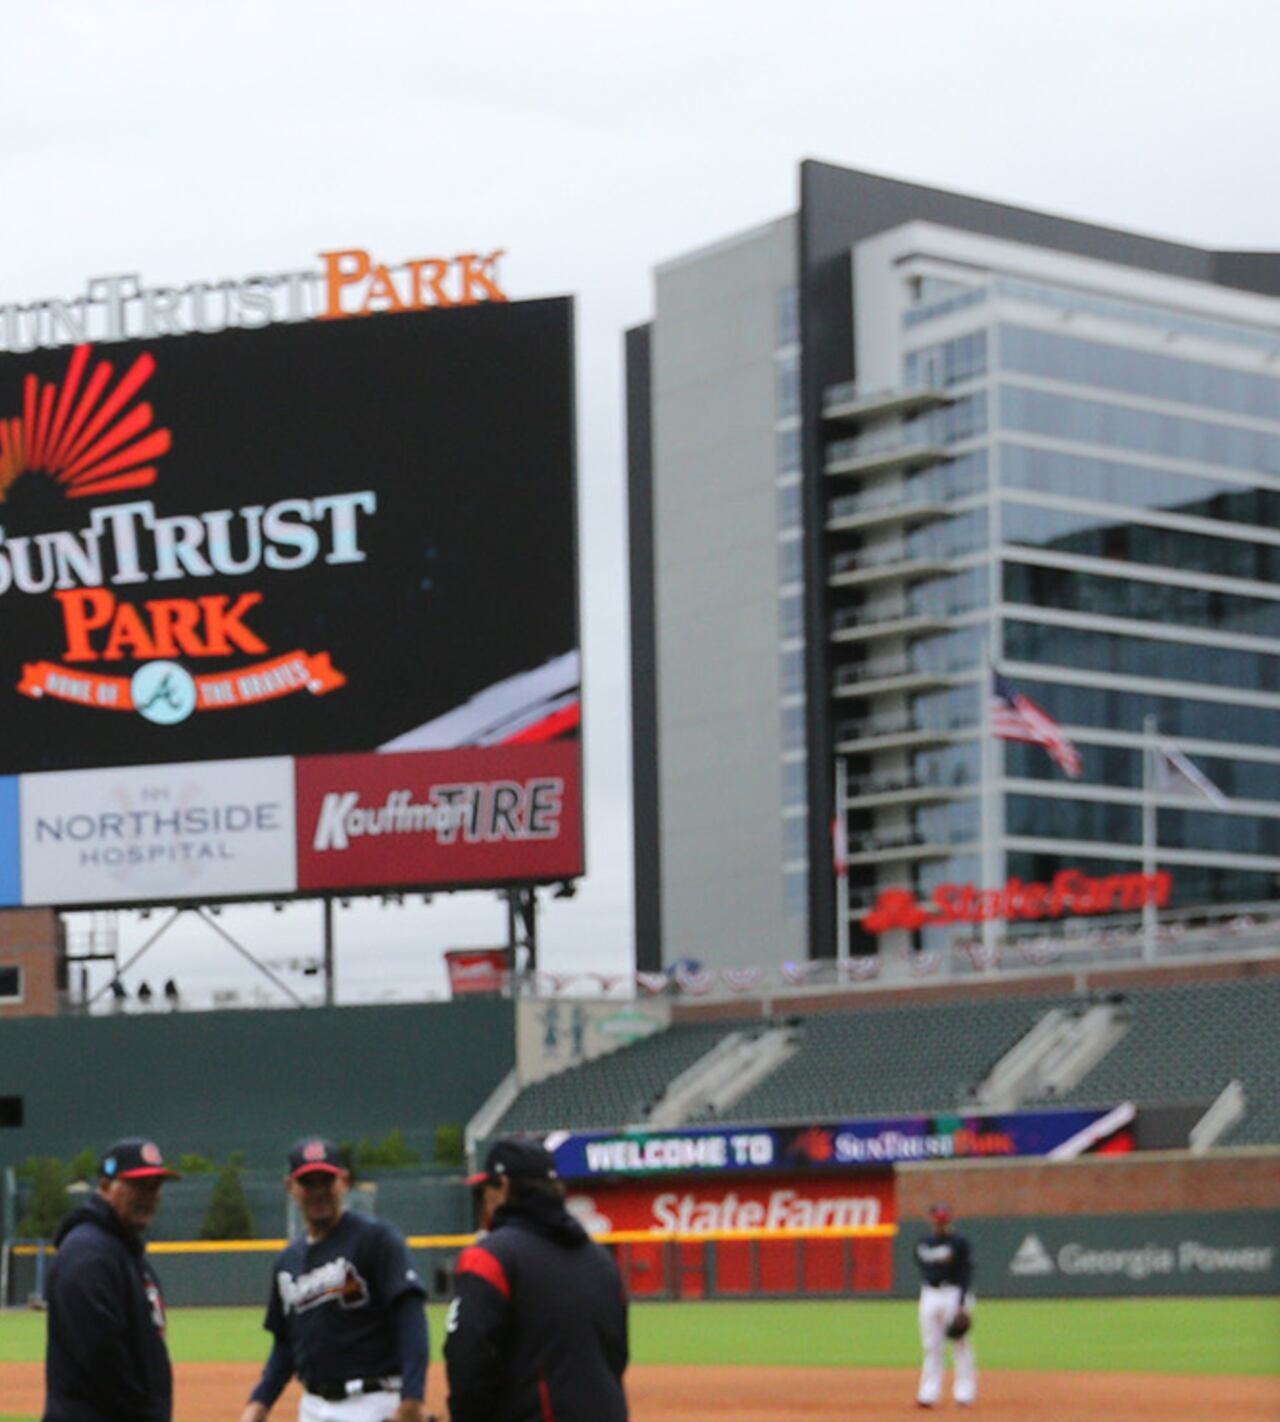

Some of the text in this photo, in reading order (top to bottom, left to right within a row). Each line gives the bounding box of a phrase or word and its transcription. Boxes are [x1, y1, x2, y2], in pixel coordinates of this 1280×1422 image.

[53, 587, 268, 661] PARK
[35, 803, 280, 842] NORTHSIDE
[313, 777, 565, 851] Kauffman TIRE
[79, 842, 236, 868] HOSPITAL
[586, 1136, 726, 1172] WELCOME
[734, 1135, 773, 1164] TO
[1057, 1240, 1273, 1279] Georgia Power
